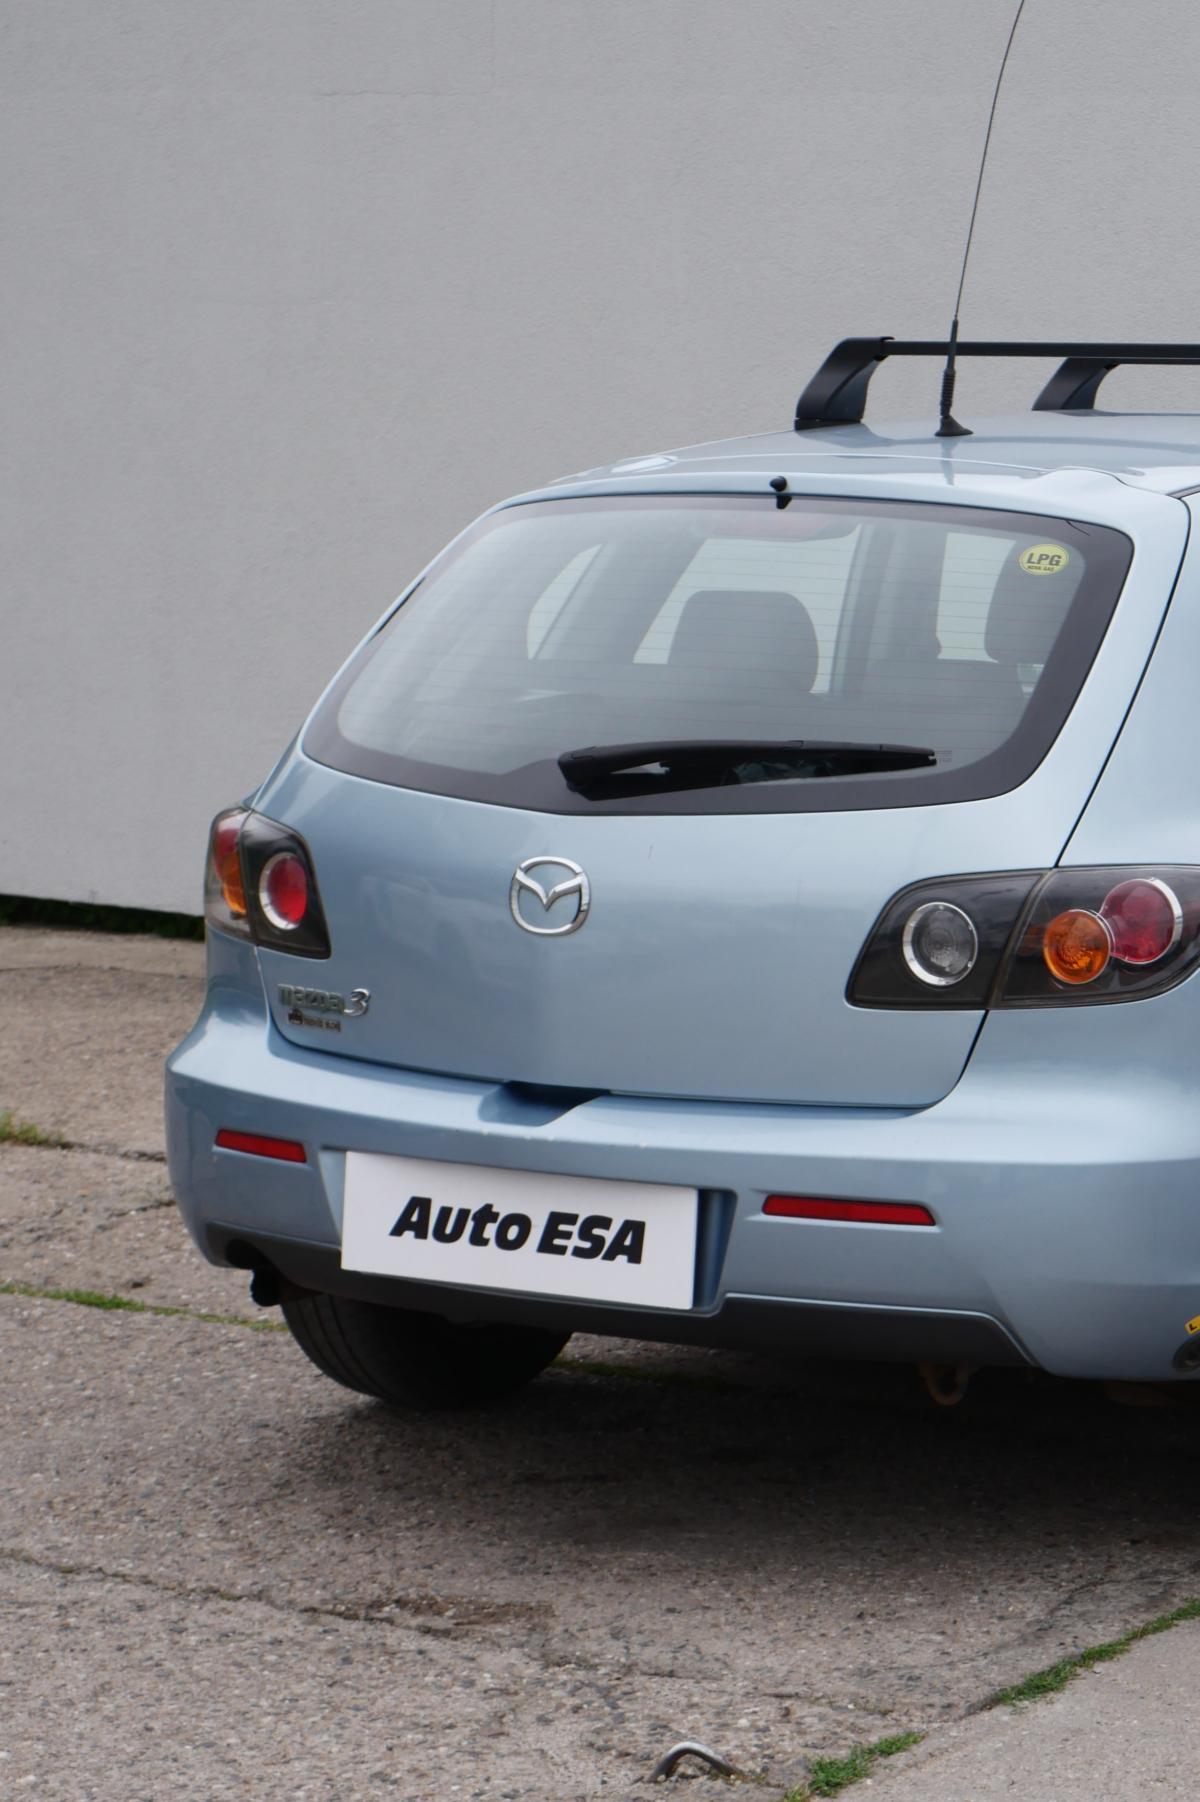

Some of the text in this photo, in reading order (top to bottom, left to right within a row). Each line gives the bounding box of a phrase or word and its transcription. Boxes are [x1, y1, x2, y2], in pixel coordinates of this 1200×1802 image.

[1026, 552, 1062, 566] LPG
[389, 1196, 646, 1265] Auto ESA
